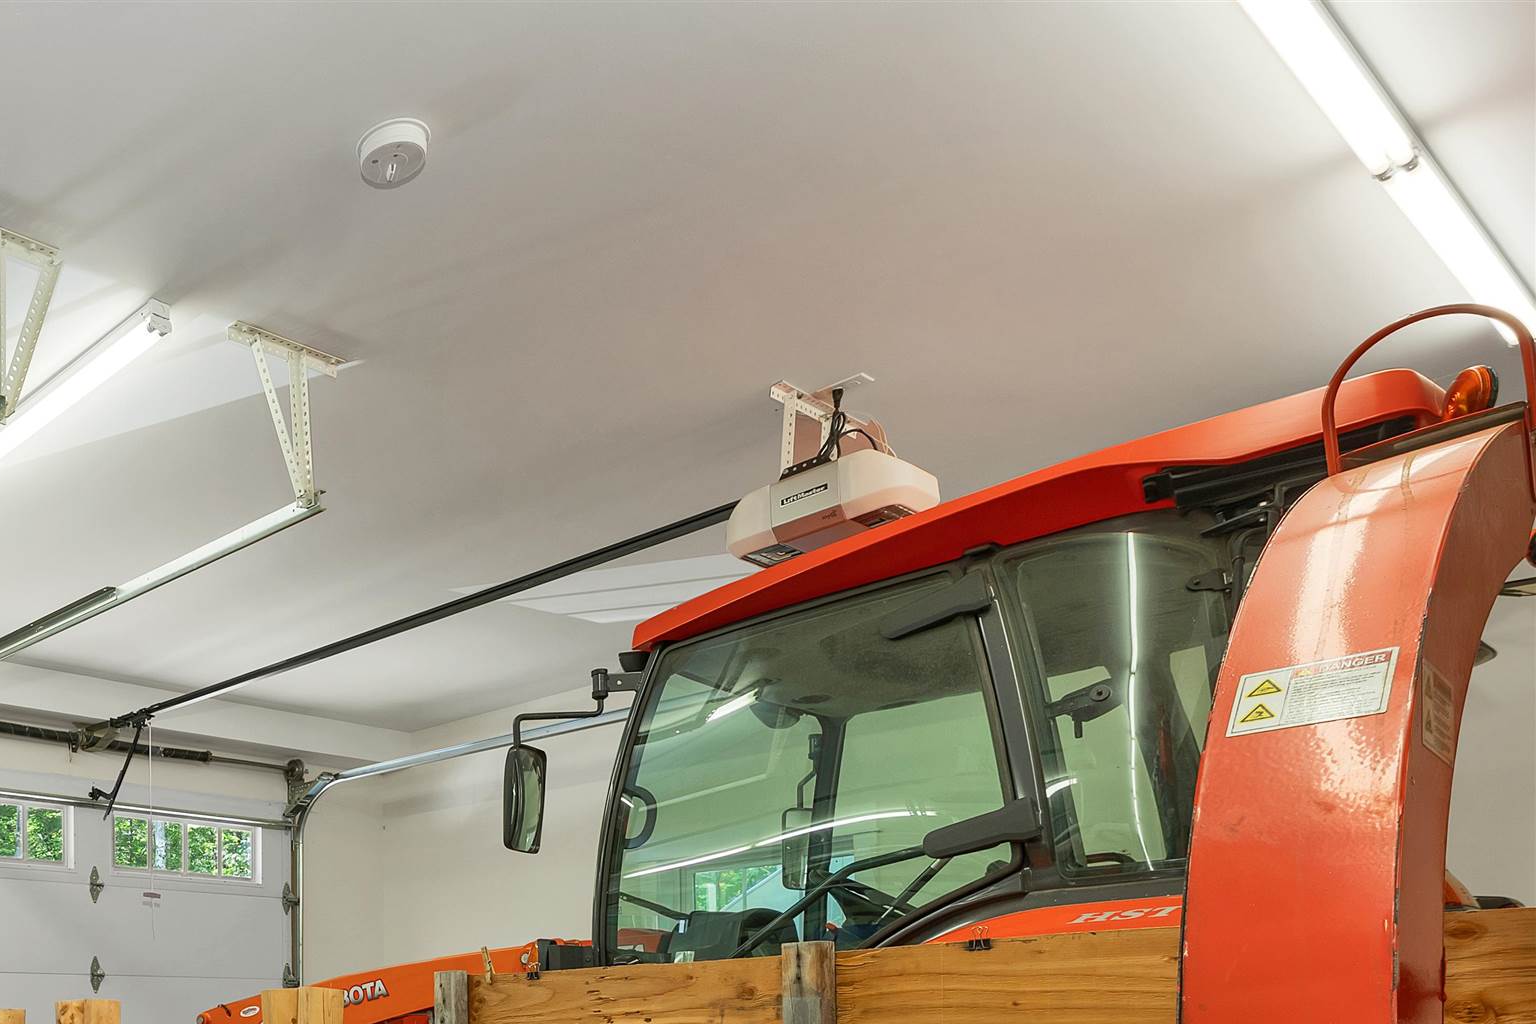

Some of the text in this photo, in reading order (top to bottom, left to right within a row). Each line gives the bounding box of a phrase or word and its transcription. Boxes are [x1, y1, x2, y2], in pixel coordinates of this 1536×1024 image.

[783, 485, 827, 504] LiftMaster
[1318, 653, 1386, 673] DANGER
[1065, 905, 1183, 925] HST
